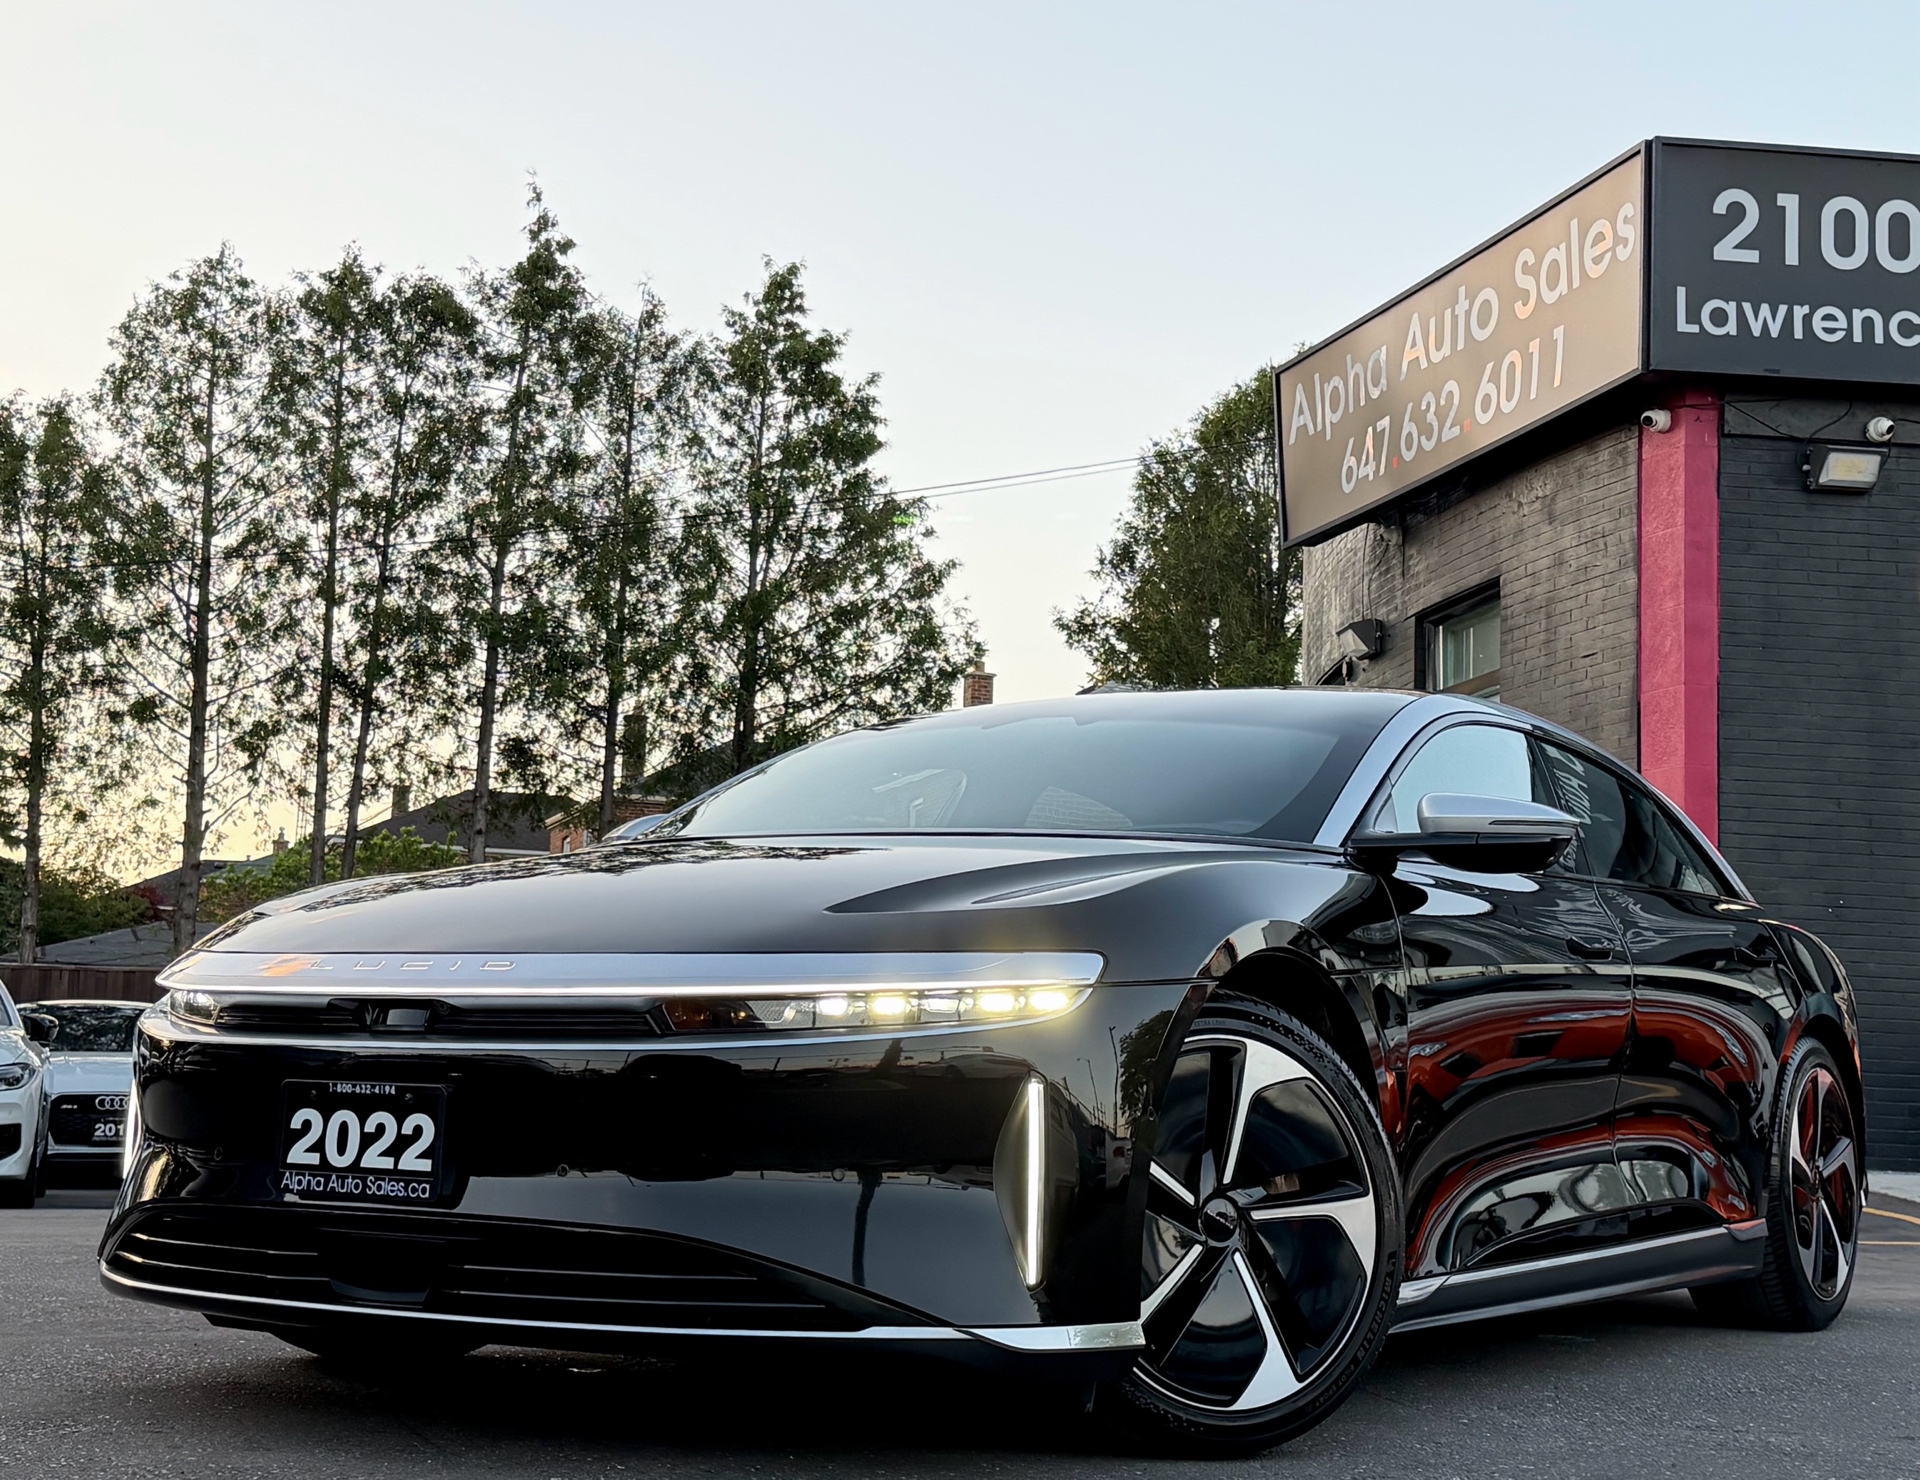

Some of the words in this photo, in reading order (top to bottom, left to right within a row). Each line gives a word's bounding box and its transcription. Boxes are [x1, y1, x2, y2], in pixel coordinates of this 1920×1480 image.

[1712, 187, 1920, 274] 2100
[1288, 345, 1388, 446] Alpha
[1399, 285, 1499, 382] Auto
[1513, 202, 1636, 320] Sales
[1676, 286, 1920, 347] Lawrenc
[1341, 324, 1565, 494] 647.632.6011
[310, 959, 517, 971] LUCID
[328, 1082, 396, 1095] 1-800-632-4194
[94, 1123, 124, 1136] 201
[286, 1107, 436, 1172] 2022
[281, 1171, 325, 1193] Alpha
[327, 1174, 363, 1194] Auto
[366, 1176, 431, 1198] Sales.ca
[1357, 1277, 1391, 1361] MICHELIN
[1314, 1387, 1337, 1407] SPORT
[1338, 1365, 1355, 1386] PILOT
